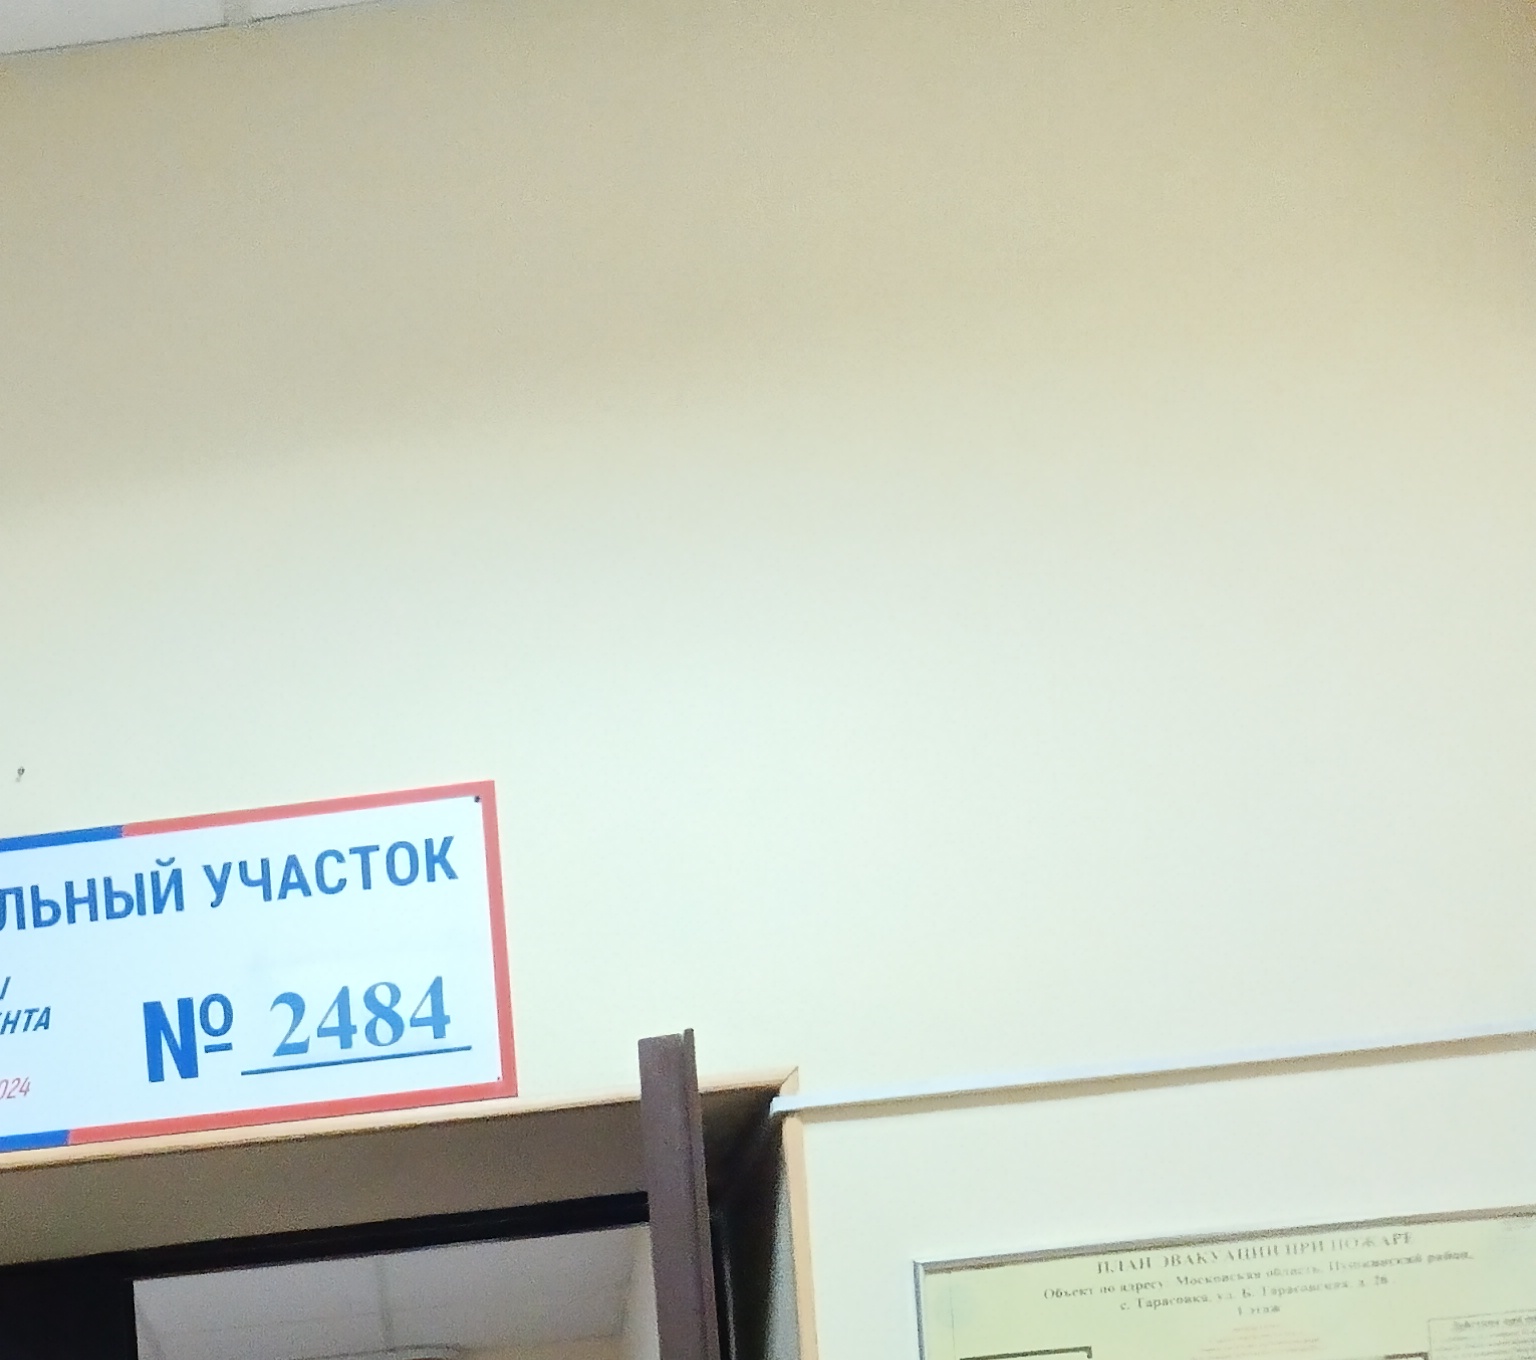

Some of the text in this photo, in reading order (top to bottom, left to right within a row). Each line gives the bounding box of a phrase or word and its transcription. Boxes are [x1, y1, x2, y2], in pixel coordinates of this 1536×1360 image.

[202, 835, 459, 909] УЧАСТОК
[143, 975, 451, 1083] № 2484
[1096, 1255, 1152, 1275] ПЛАН
